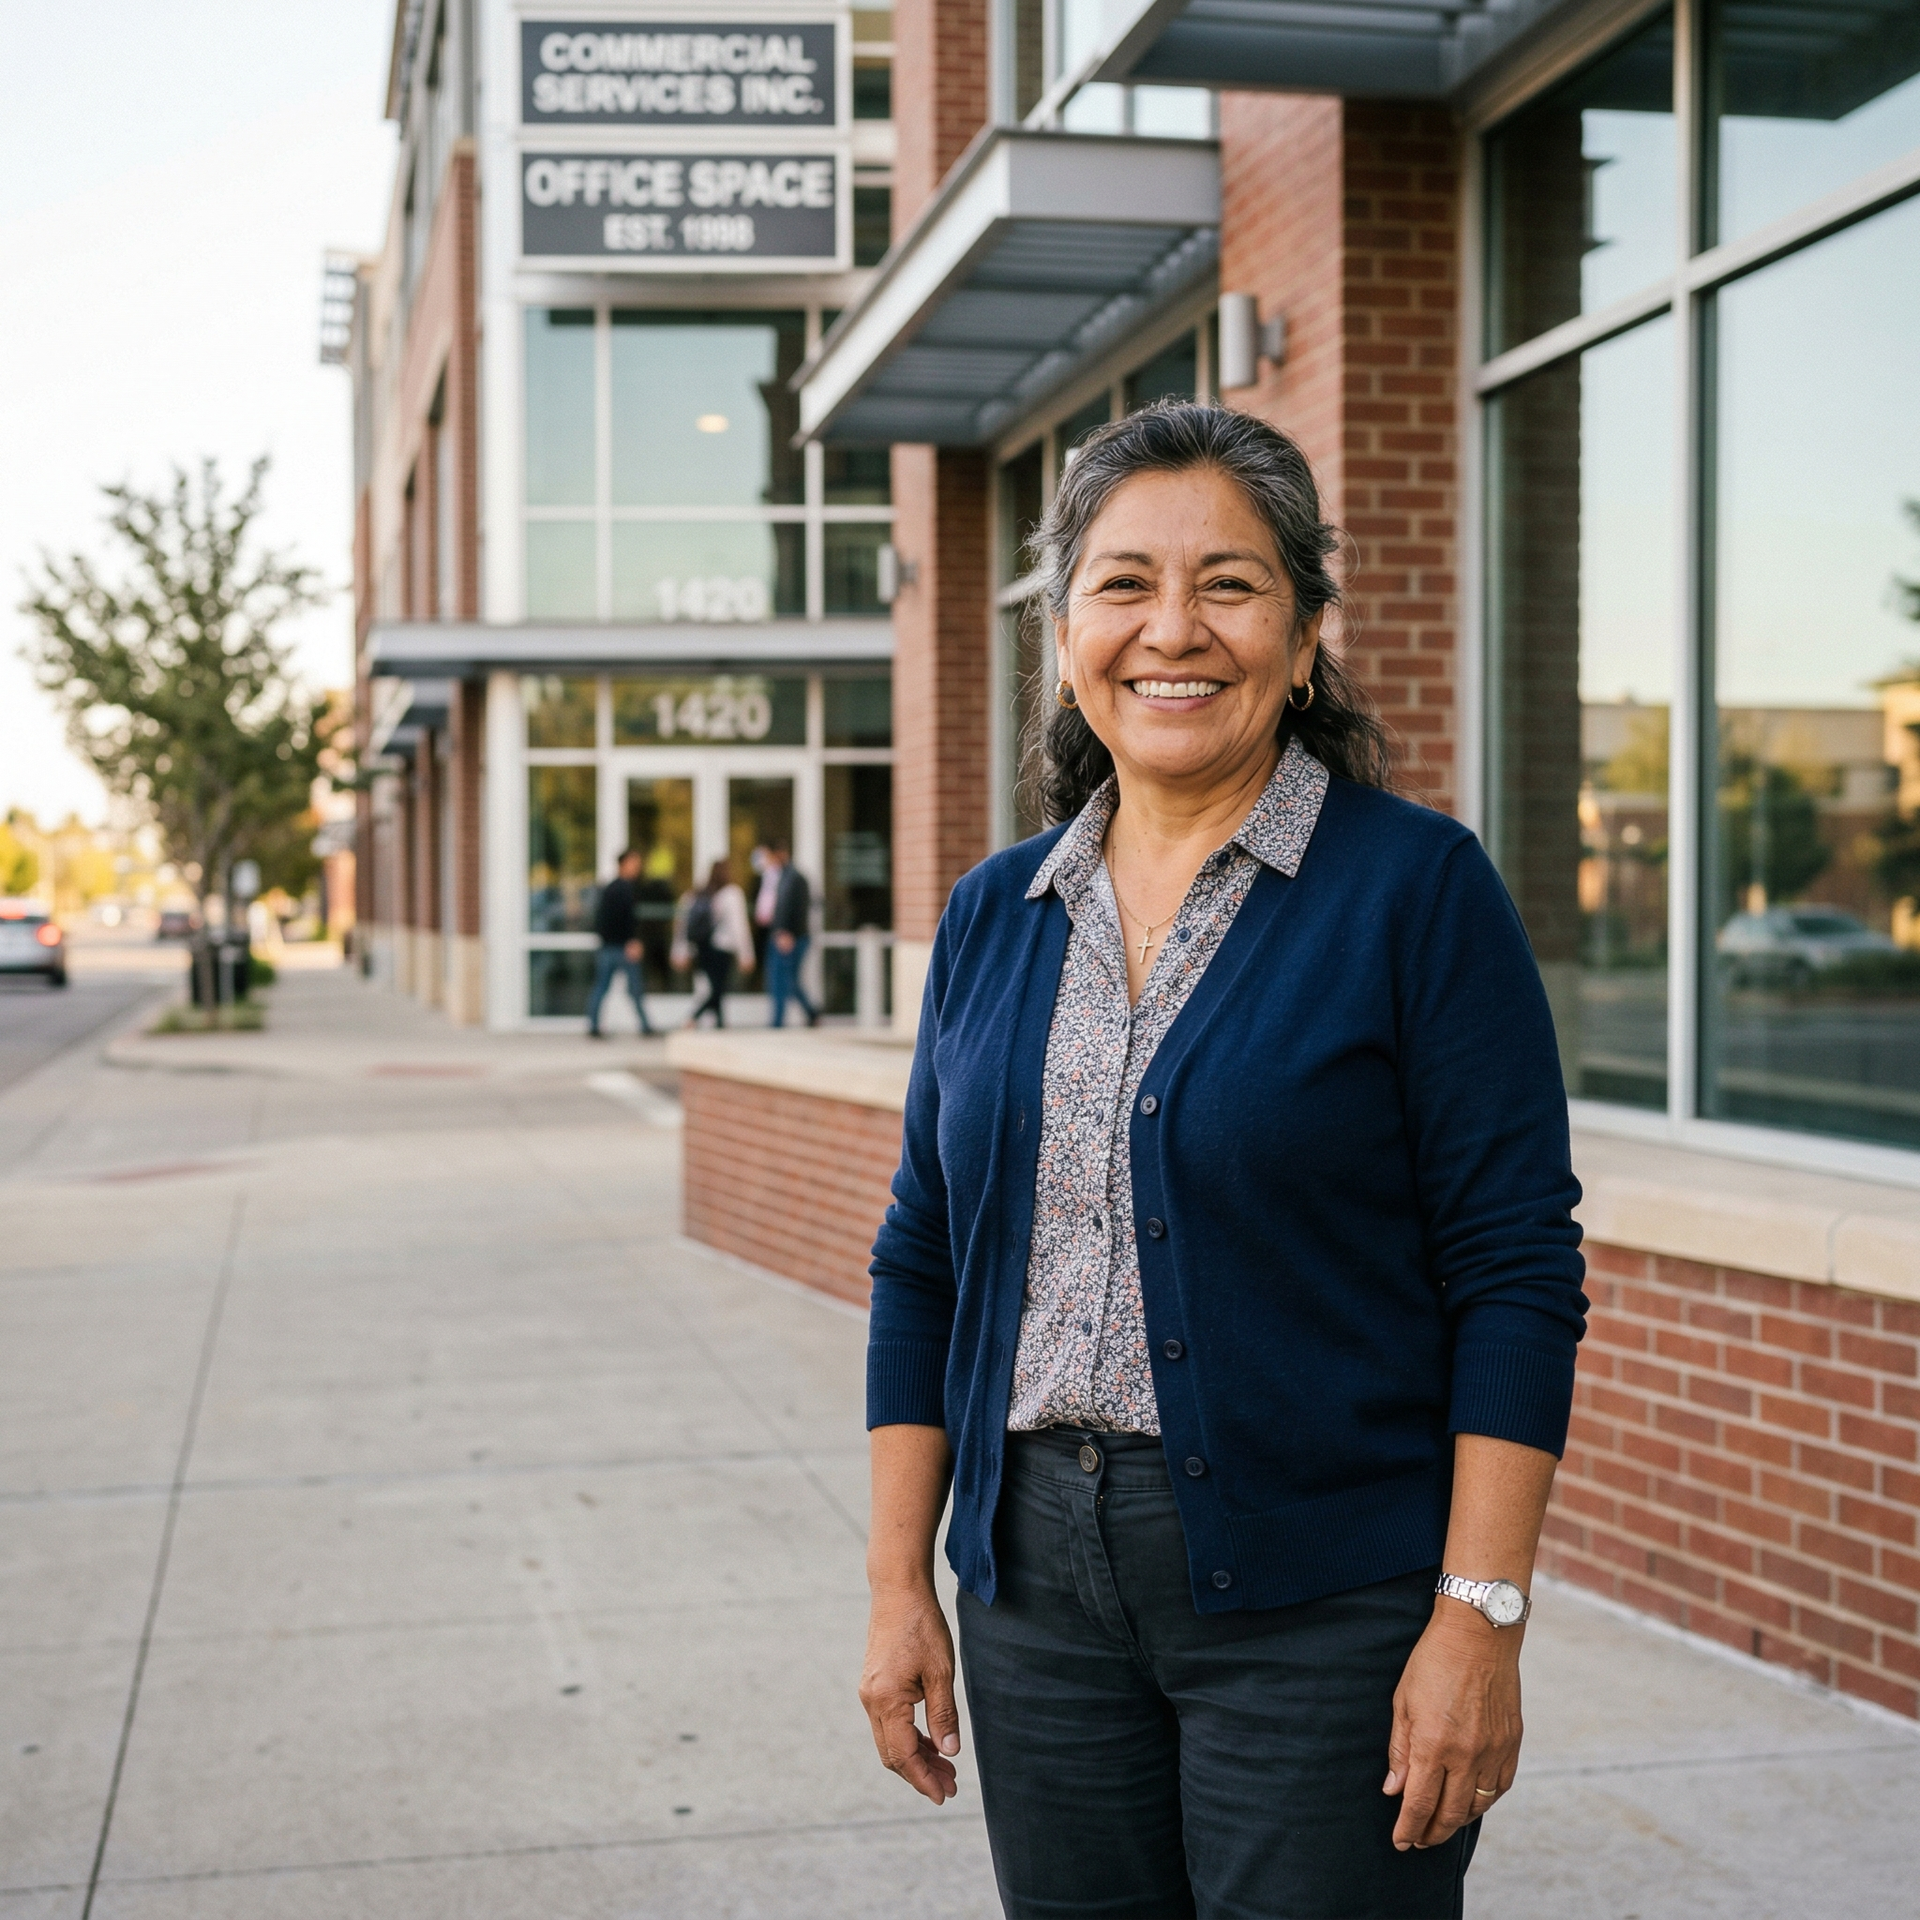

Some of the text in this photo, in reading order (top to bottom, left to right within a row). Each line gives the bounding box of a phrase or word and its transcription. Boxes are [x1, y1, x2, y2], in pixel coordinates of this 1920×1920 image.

[540, 33, 816, 72] COMMERCIAL
[533, 74, 824, 115] SERVICES INC.
[525, 160, 833, 208] OFFICE SPACE
[604, 214, 674, 250] EST.
[655, 691, 772, 739] 1420
